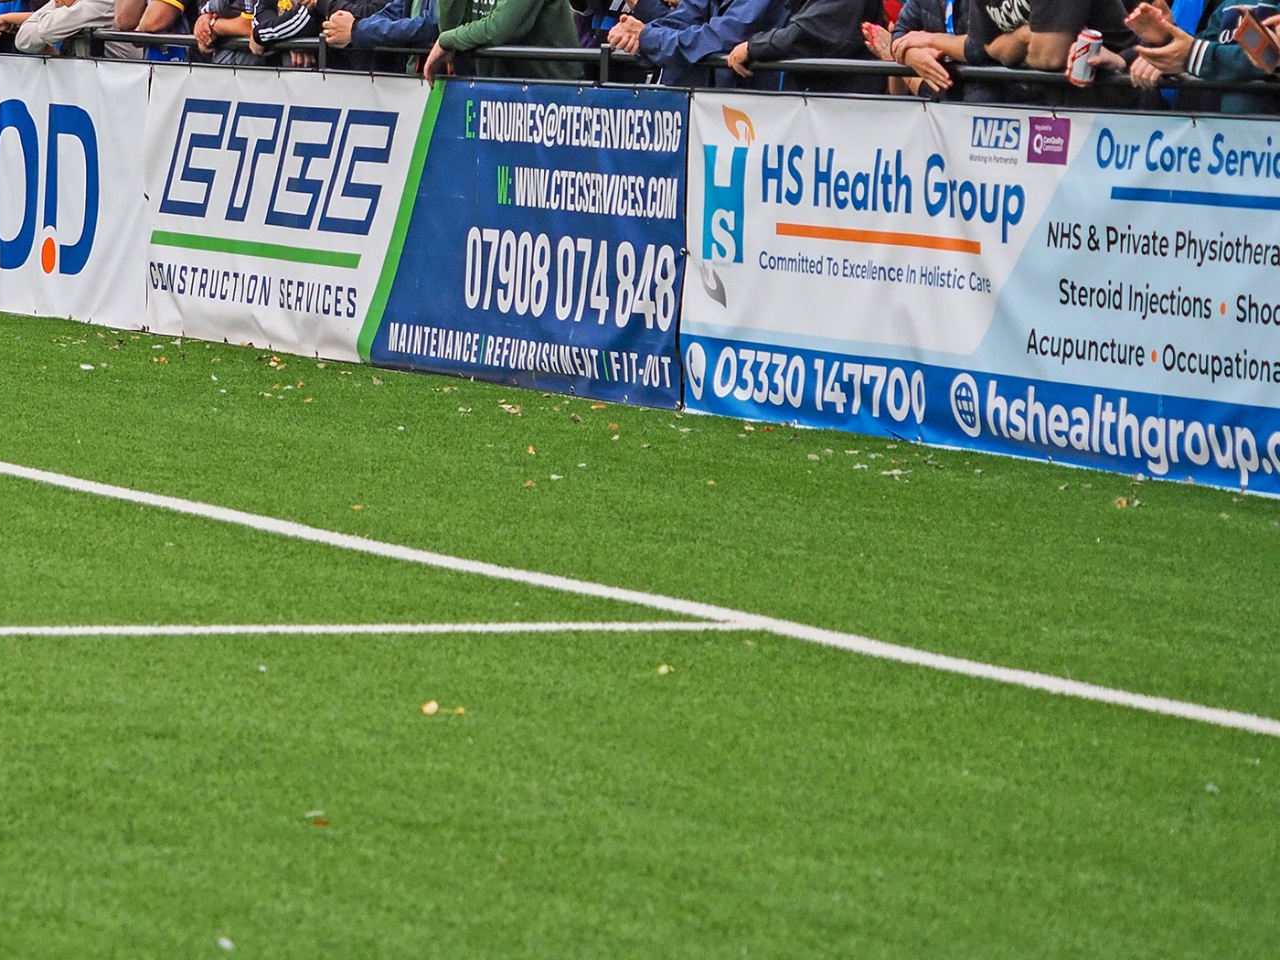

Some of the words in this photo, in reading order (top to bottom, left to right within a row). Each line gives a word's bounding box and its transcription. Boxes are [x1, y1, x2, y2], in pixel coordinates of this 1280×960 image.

[466, 100, 476, 139] E:
[479, 100, 682, 152] ENQUIRIES@CTECSERVICES.ORG
[972, 118, 1020, 149] NHS
[1096, 127, 1141, 171] Our
[1146, 130, 1200, 173] Core
[969, 154, 988, 164] Working
[993, 155, 1018, 166] Partnership
[497, 165, 512, 205] W:
[515, 167, 677, 219] WWW.CTECSERVICES.COM
[762, 144, 804, 206] HS
[813, 147, 912, 214] Health
[924, 153, 1026, 244] Group
[1047, 220, 1081, 251] NHS
[1087, 227, 1101, 252] &
[1106, 225, 1169, 258] Private
[1175, 229, 1280, 268] Physiothera
[150, 261, 271, 306] CONSTRUCTION
[279, 278, 357, 318] SERVICES
[464, 226, 551, 318] 07908
[555, 235, 609, 325] 074
[615, 241, 676, 332] 848
[759, 250, 823, 277] Committed
[826, 256, 840, 277] To
[842, 258, 903, 284] Excellence
[905, 264, 917, 284] In
[920, 267, 966, 290] Holistic
[969, 271, 992, 294] Care
[1059, 278, 1123, 311] Steroid
[1129, 285, 1212, 321] Injections
[388, 322, 480, 363] MAINTENANCE
[484, 335, 599, 380] REFURBISHMENT
[1026, 328, 1145, 367] Acupuncture
[1162, 342, 1280, 384] Occupationa
[713, 345, 805, 409] 03330
[814, 357, 926, 425] 147700
